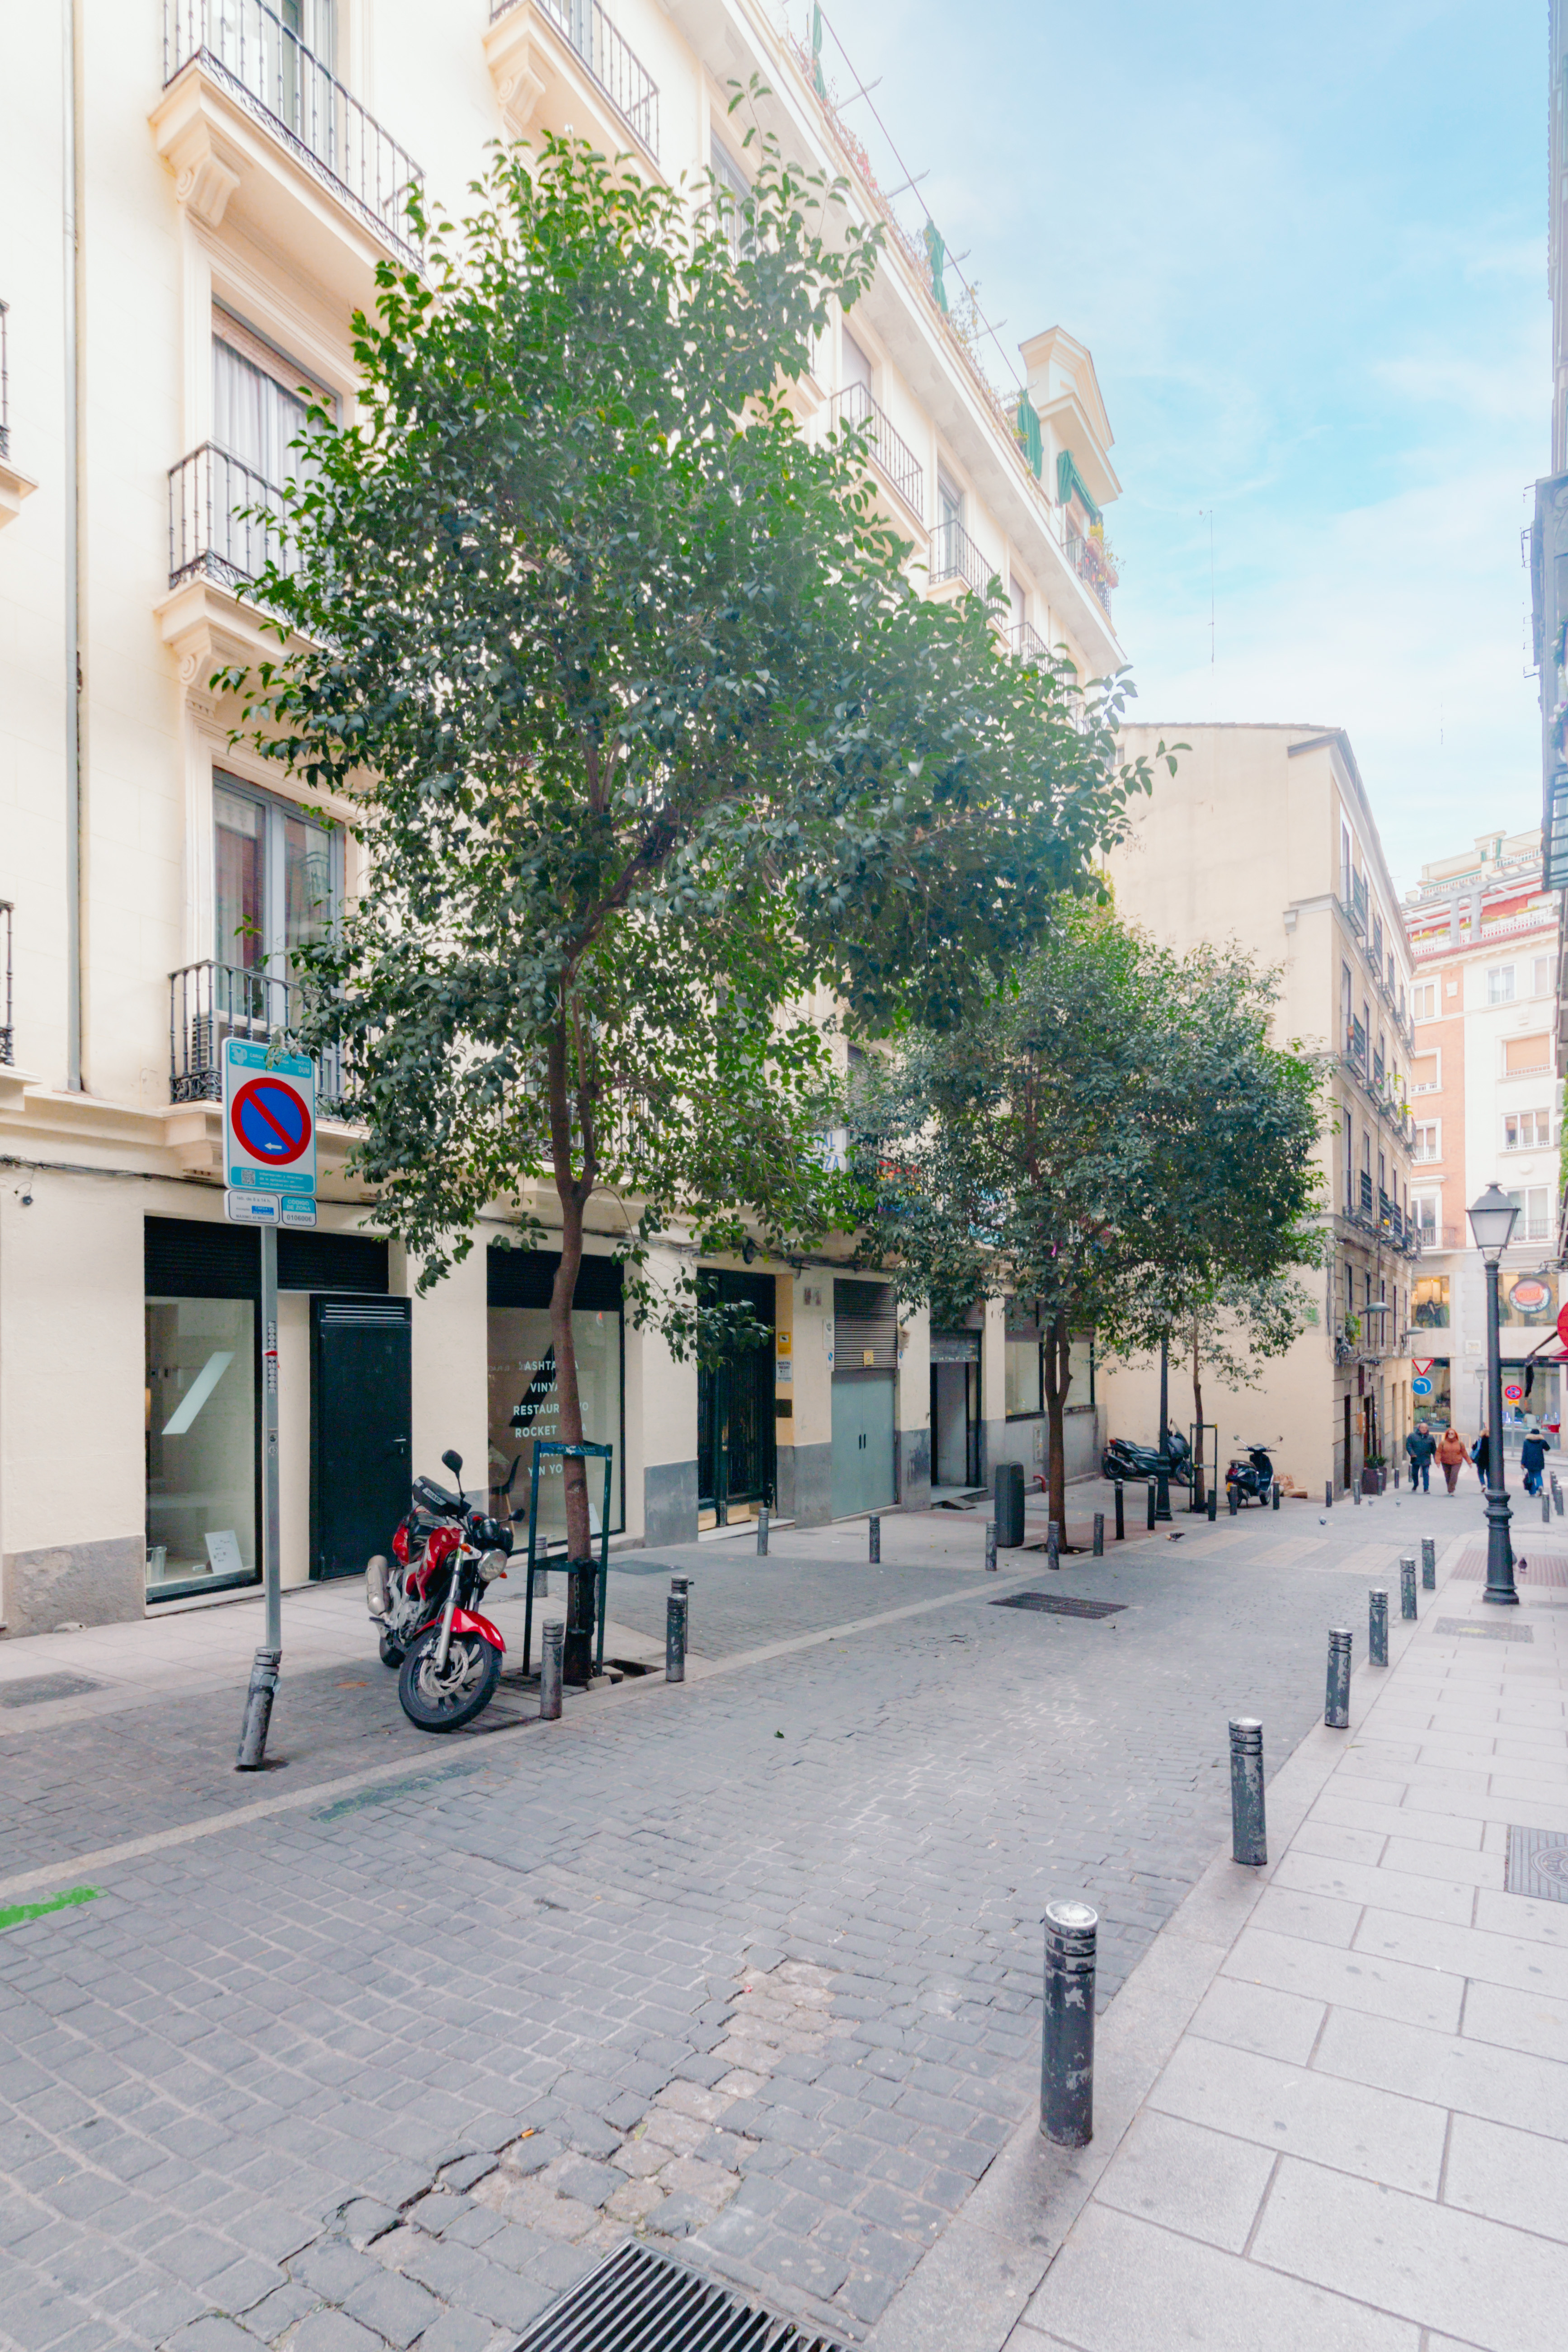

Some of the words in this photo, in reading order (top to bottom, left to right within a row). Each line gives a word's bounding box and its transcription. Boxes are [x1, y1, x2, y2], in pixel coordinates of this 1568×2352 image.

[298, 1066, 310, 1075] DUM
[515, 1425, 556, 1438] ROCKET
[527, 1466, 546, 1477] YN
